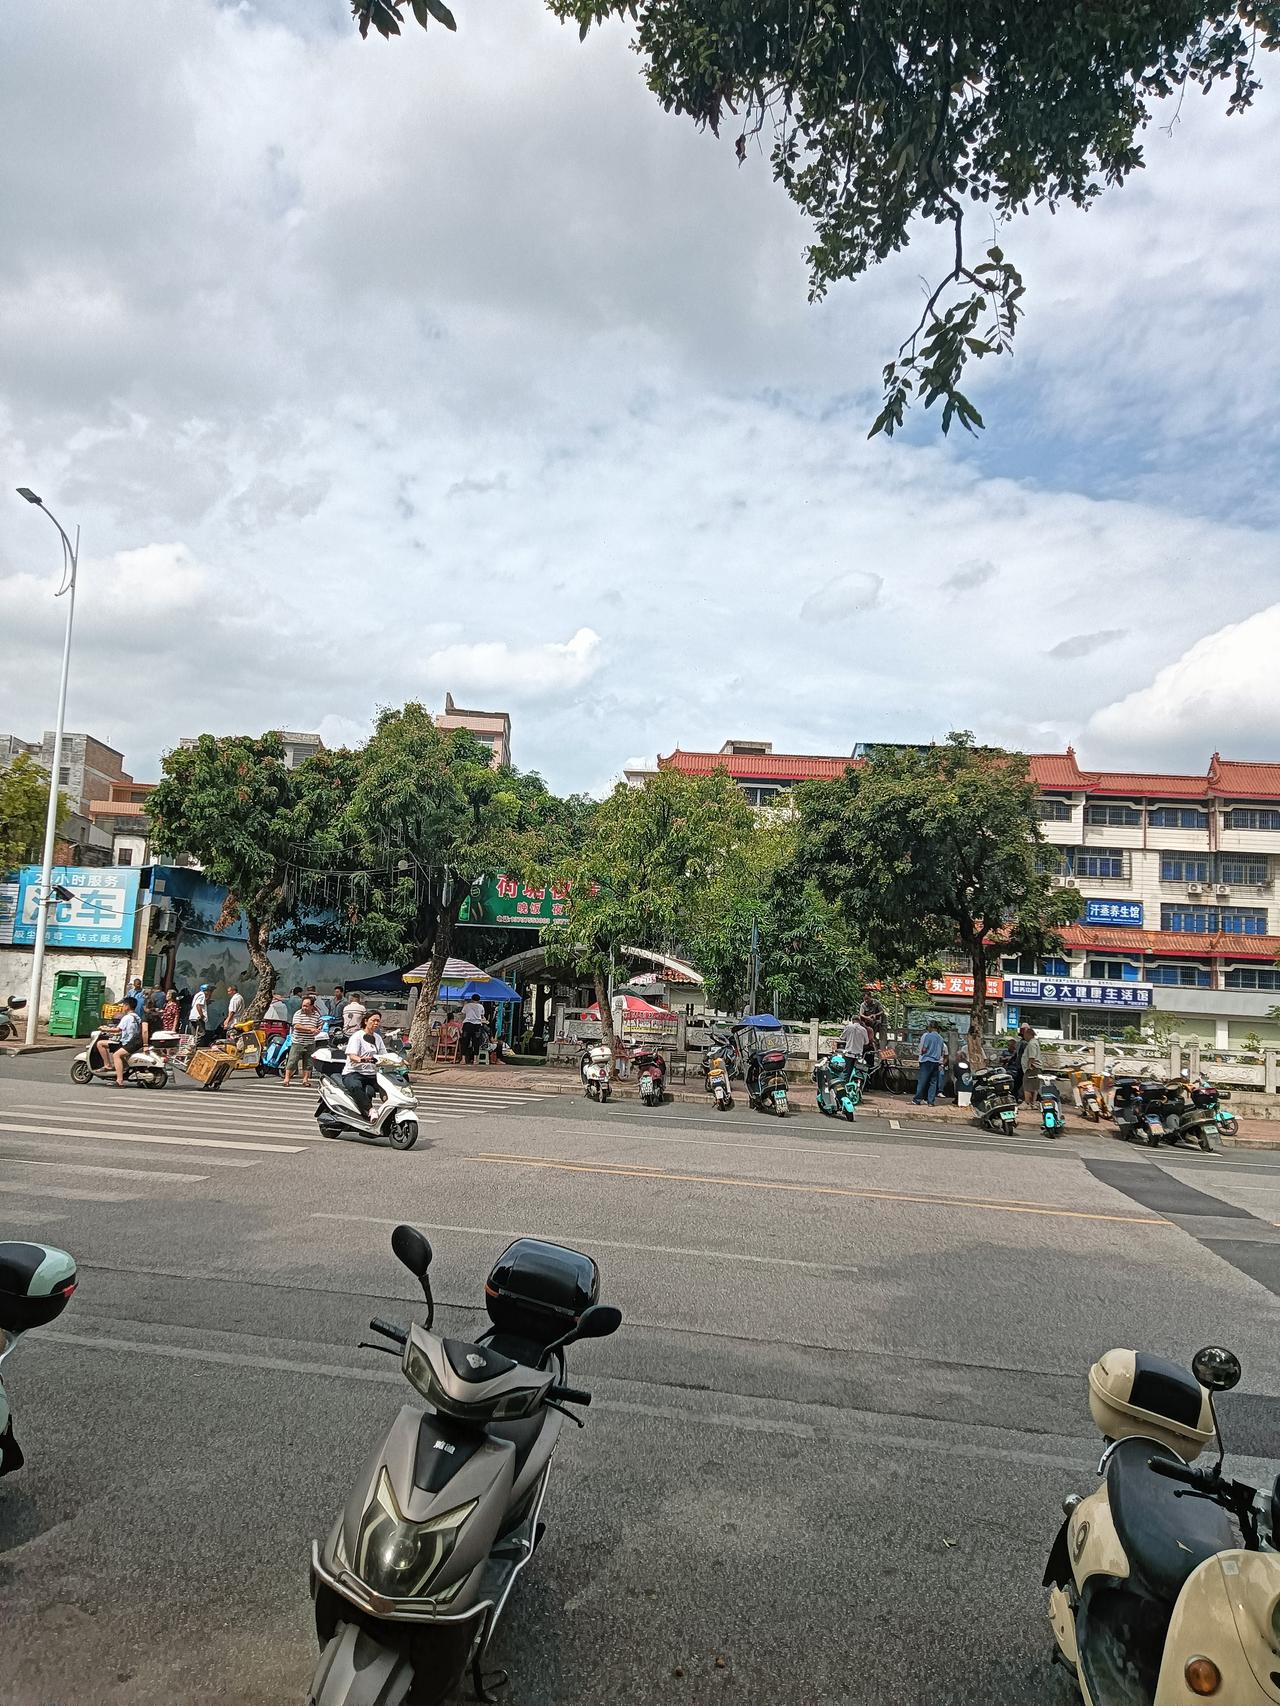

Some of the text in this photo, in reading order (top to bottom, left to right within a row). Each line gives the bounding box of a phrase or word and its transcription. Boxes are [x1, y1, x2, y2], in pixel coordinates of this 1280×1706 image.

[34, 873, 119, 887] 2小时服务
[1090, 904, 1140, 919] 汗蒸养生馆
[1060, 985, 1149, 1002] 大健康生活馆
